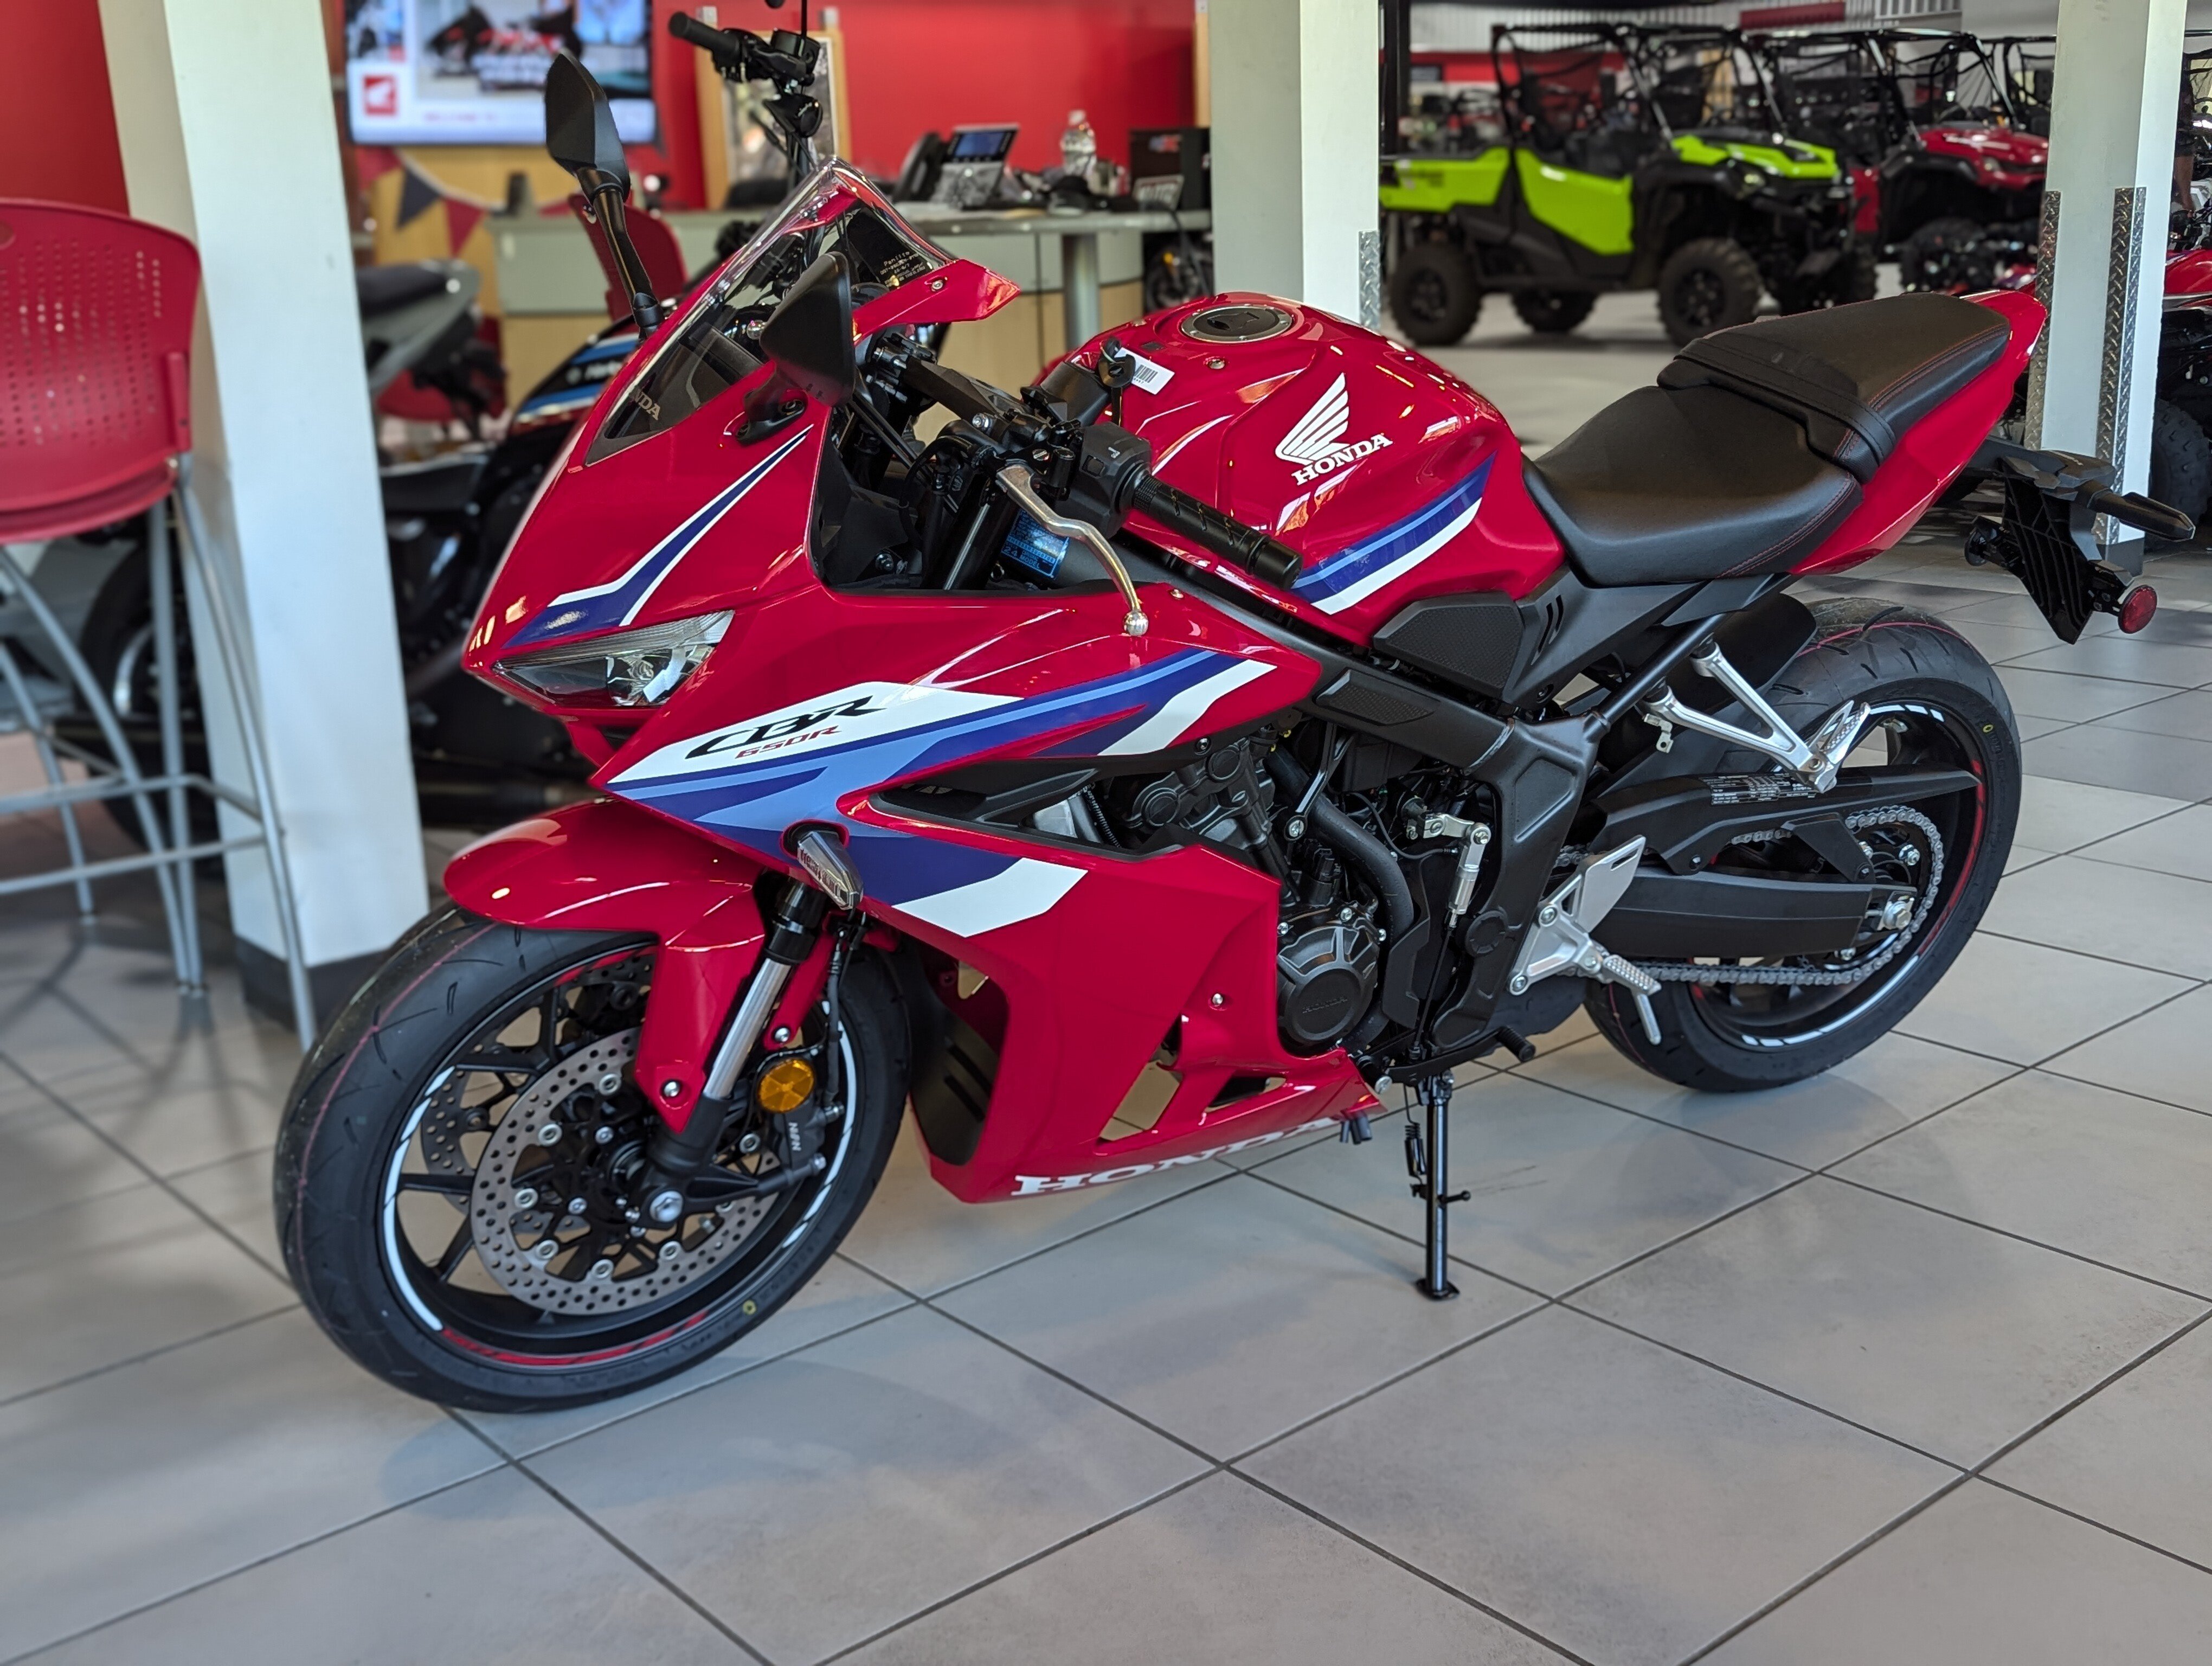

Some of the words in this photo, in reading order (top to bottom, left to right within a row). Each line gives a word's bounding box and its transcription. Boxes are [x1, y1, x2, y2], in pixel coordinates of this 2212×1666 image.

[1291, 433, 1393, 486] HONDA
[1020, 554, 1040, 569] MODEL
[685, 695, 888, 760] CBR
[735, 725, 842, 759] 650R
